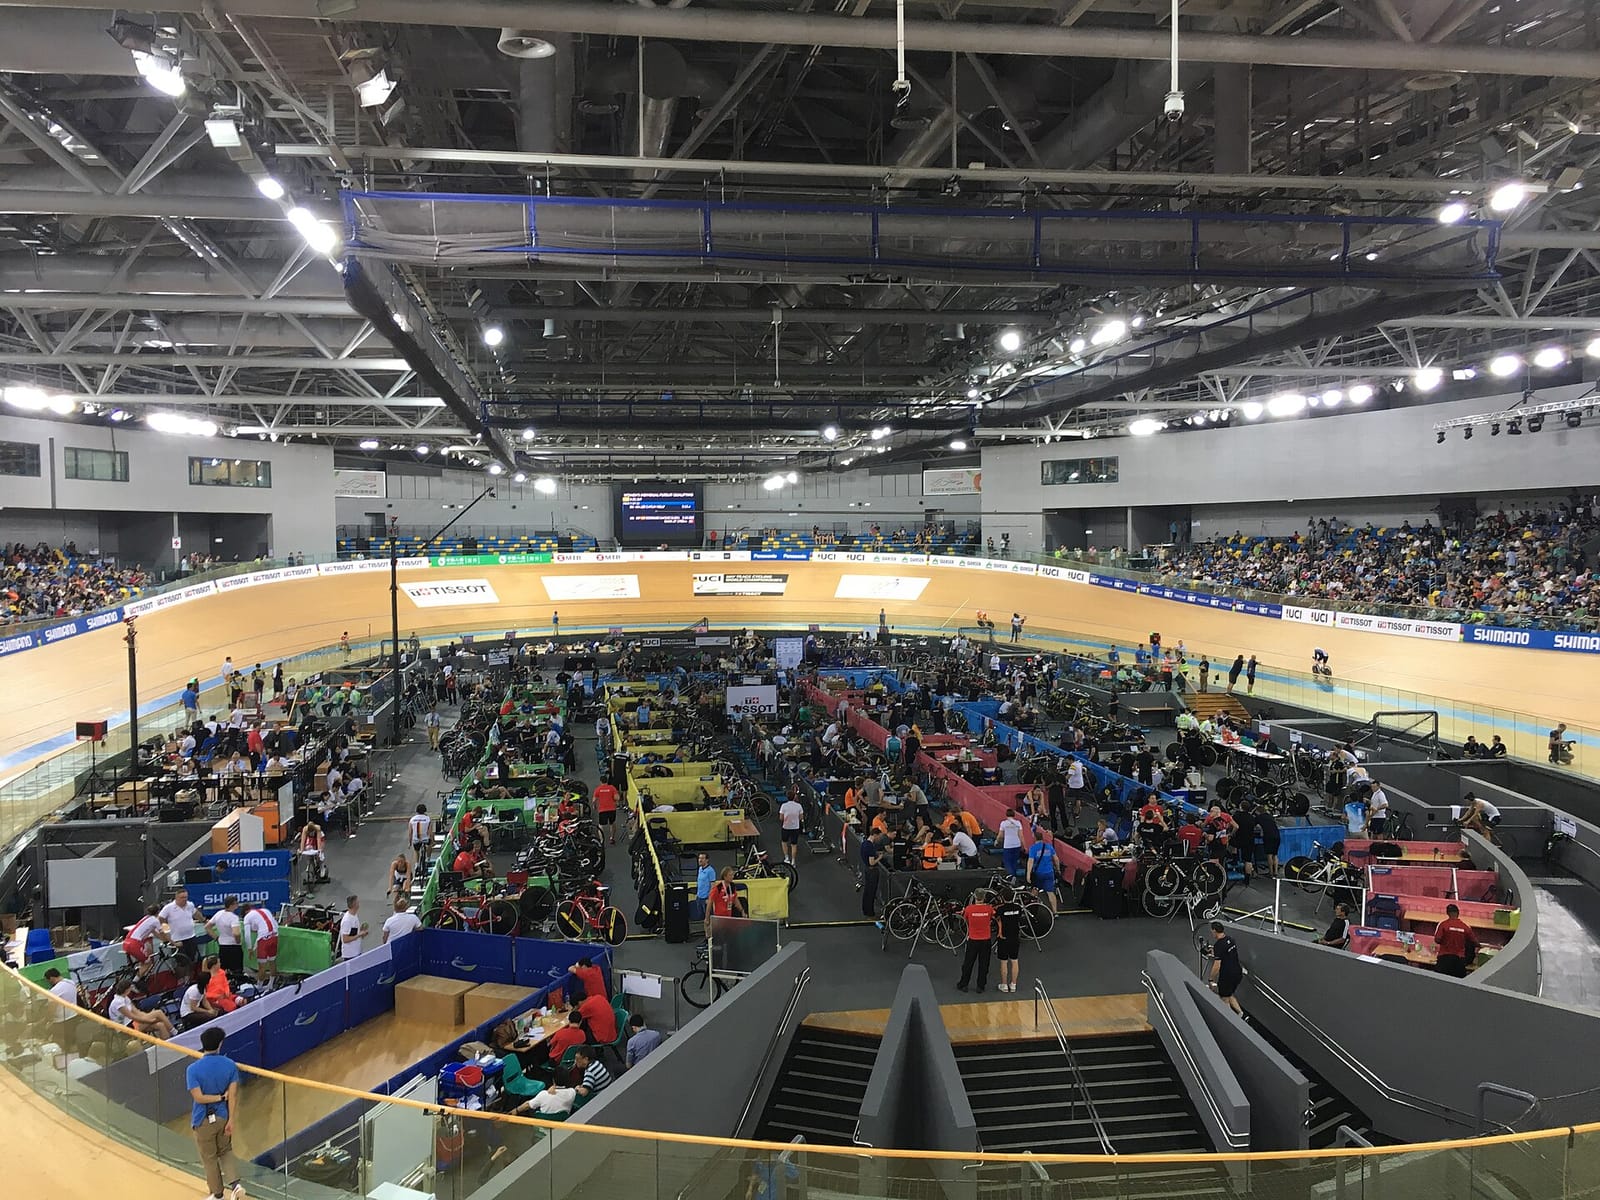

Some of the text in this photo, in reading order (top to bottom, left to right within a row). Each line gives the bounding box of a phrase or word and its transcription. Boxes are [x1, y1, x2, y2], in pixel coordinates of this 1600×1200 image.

[1045, 568, 1059, 577] UCI
[1071, 572, 1084, 581] UCI
[430, 585, 487, 595] TISSOT
[87, 611, 118, 629] SHIMANO
[1288, 610, 1302, 620] UCI
[1314, 613, 1328, 623] UCI
[45, 623, 76, 641] SHIMANO
[1474, 628, 1530, 644] SHIMANO
